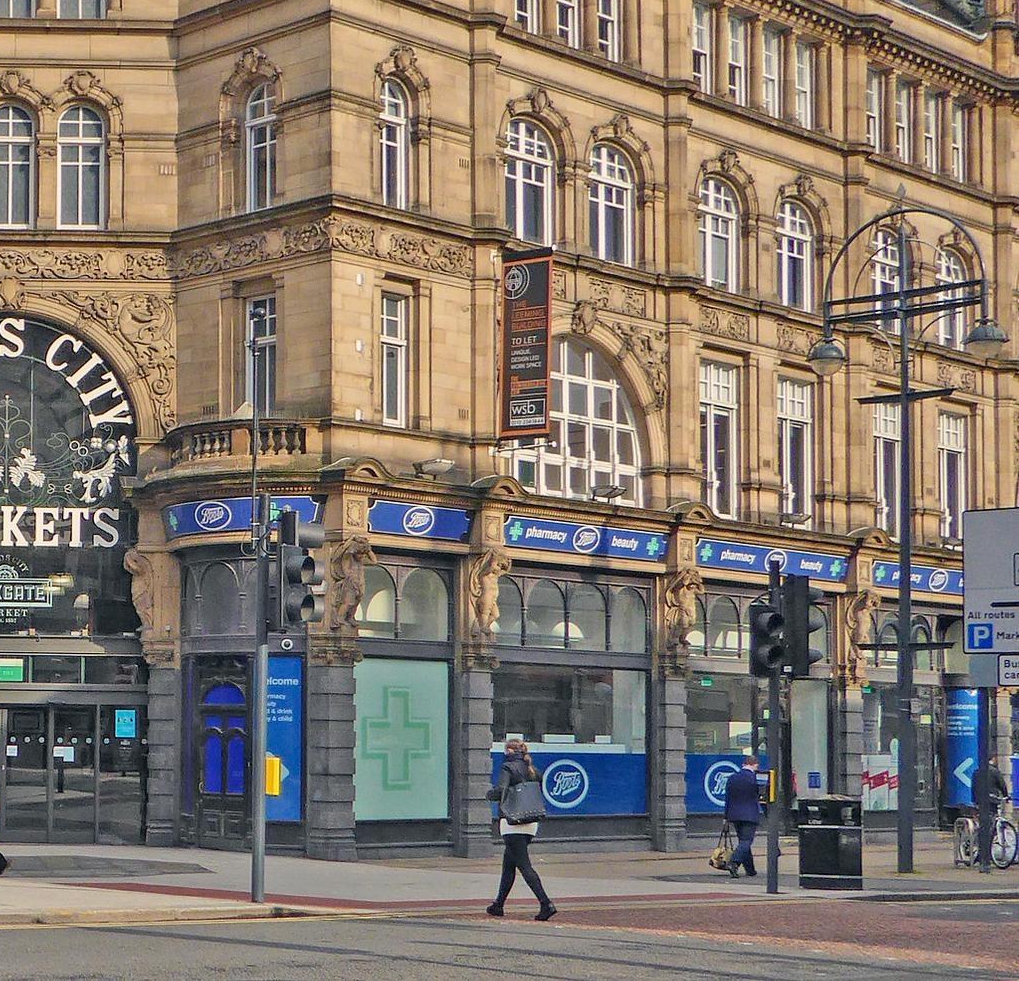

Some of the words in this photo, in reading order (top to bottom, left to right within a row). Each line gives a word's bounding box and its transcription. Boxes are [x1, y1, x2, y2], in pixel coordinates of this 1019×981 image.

[523, 336, 537, 344] LET
[45, 334, 133, 428] CITY
[512, 400, 535, 415] wsb
[525, 525, 568, 543] pharmacy
[611, 535, 639, 551] beauty
[12, 558, 30, 572] CITY
[720, 549, 756, 565] pharmacy
[800, 559, 823, 573] beauty
[968, 611, 981, 619] All
[984, 611, 1015, 619] routes
[550, 771, 581, 796] Boots
